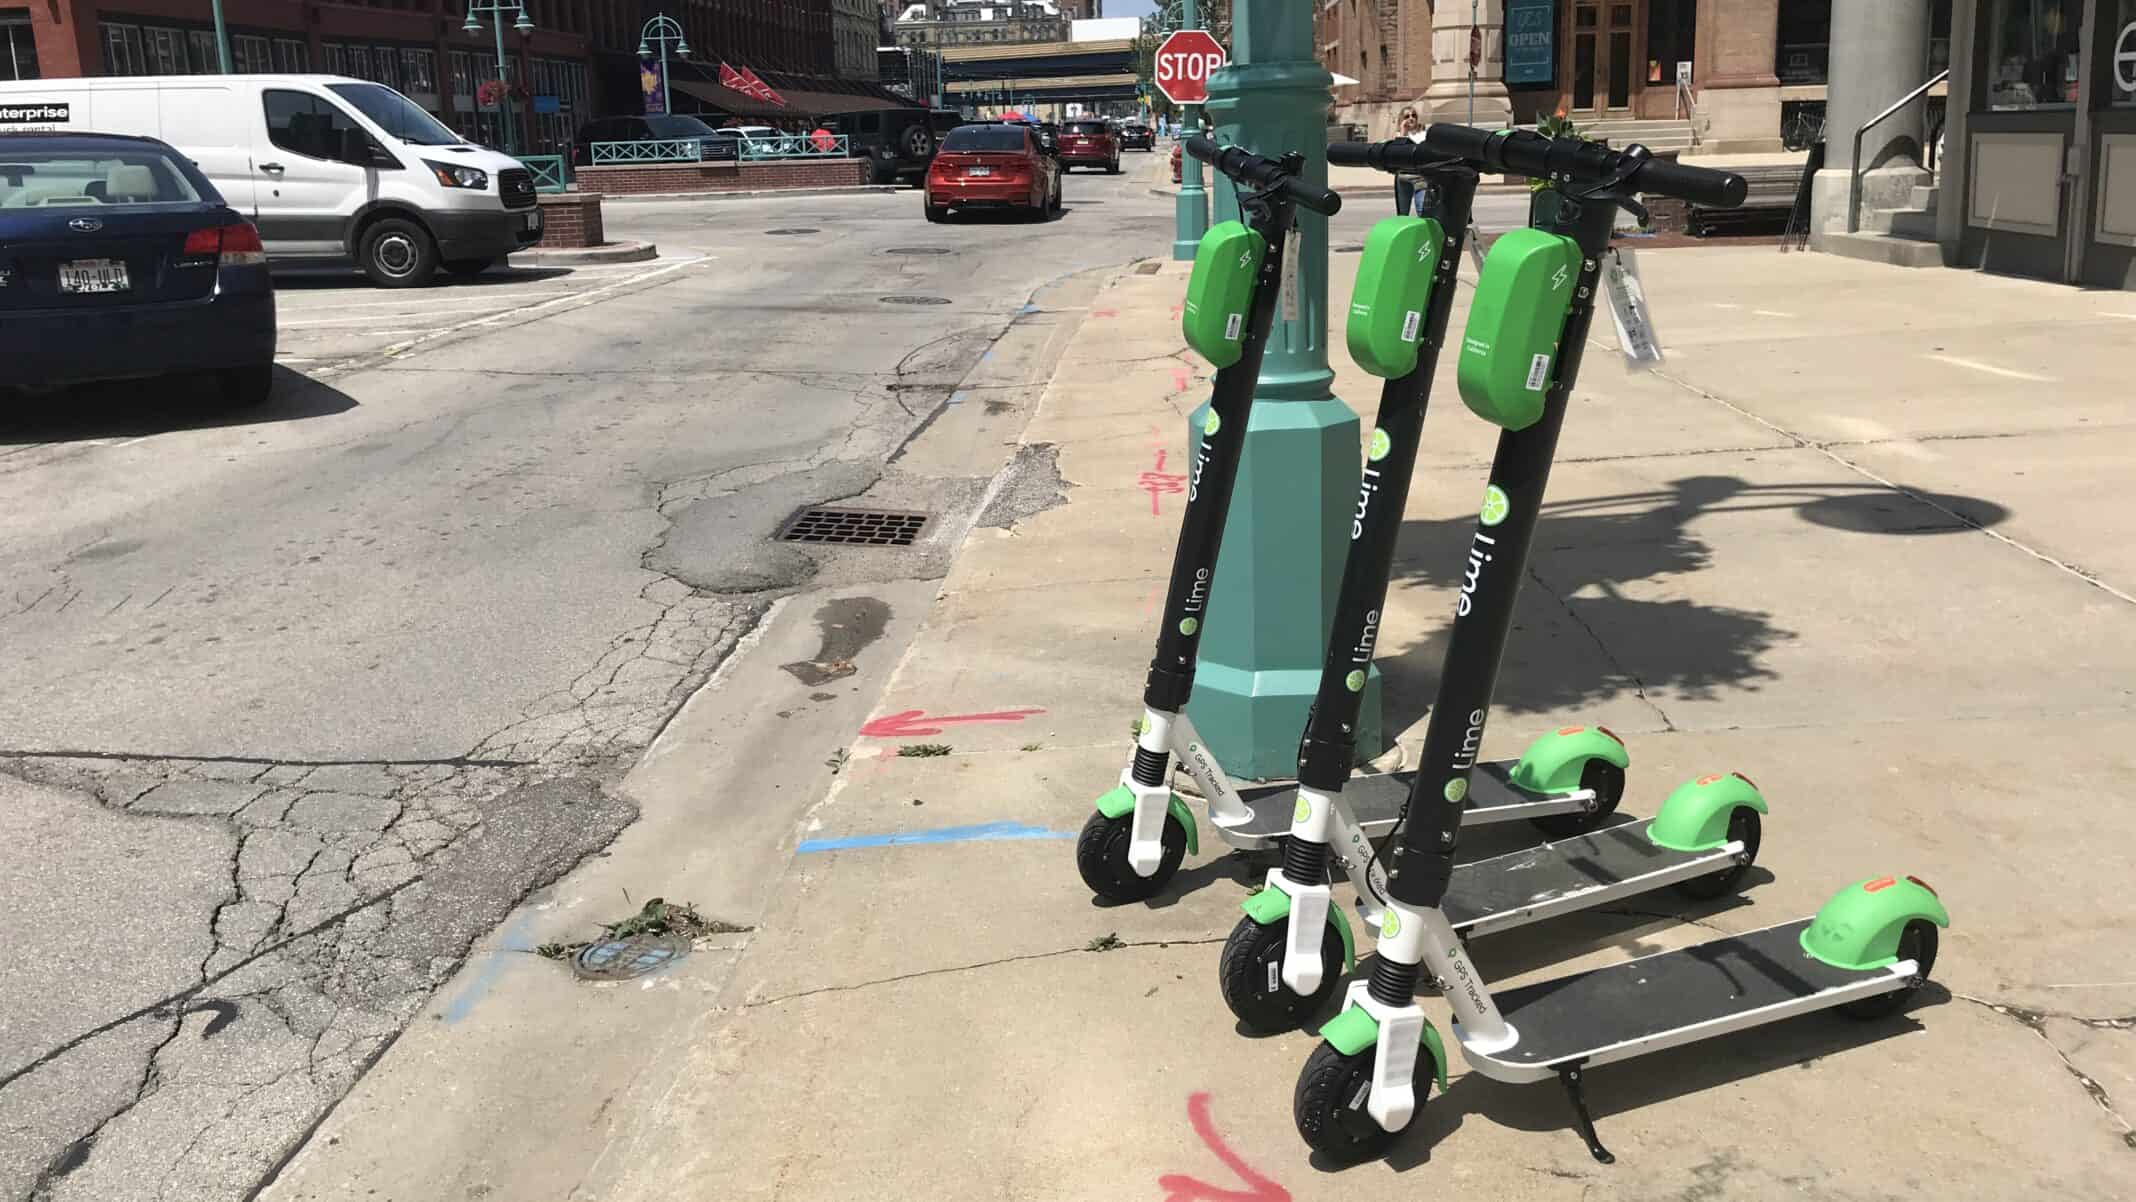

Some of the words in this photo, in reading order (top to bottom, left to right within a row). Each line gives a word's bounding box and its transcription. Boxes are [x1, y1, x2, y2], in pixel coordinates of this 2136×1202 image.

[1511, 31, 1550, 47] OPEN
[1159, 52, 1221, 81] STOP
[0, 105, 68, 121] terprise
[1351, 467, 1380, 540] Lime
[1184, 567, 1209, 612] Lime
[1456, 531, 1496, 617] Lime
[1351, 609, 1380, 663] Lime
[1452, 708, 1485, 769] Lime
[1454, 959, 1469, 981] GPS
[1464, 978, 1488, 1014] Tracked
